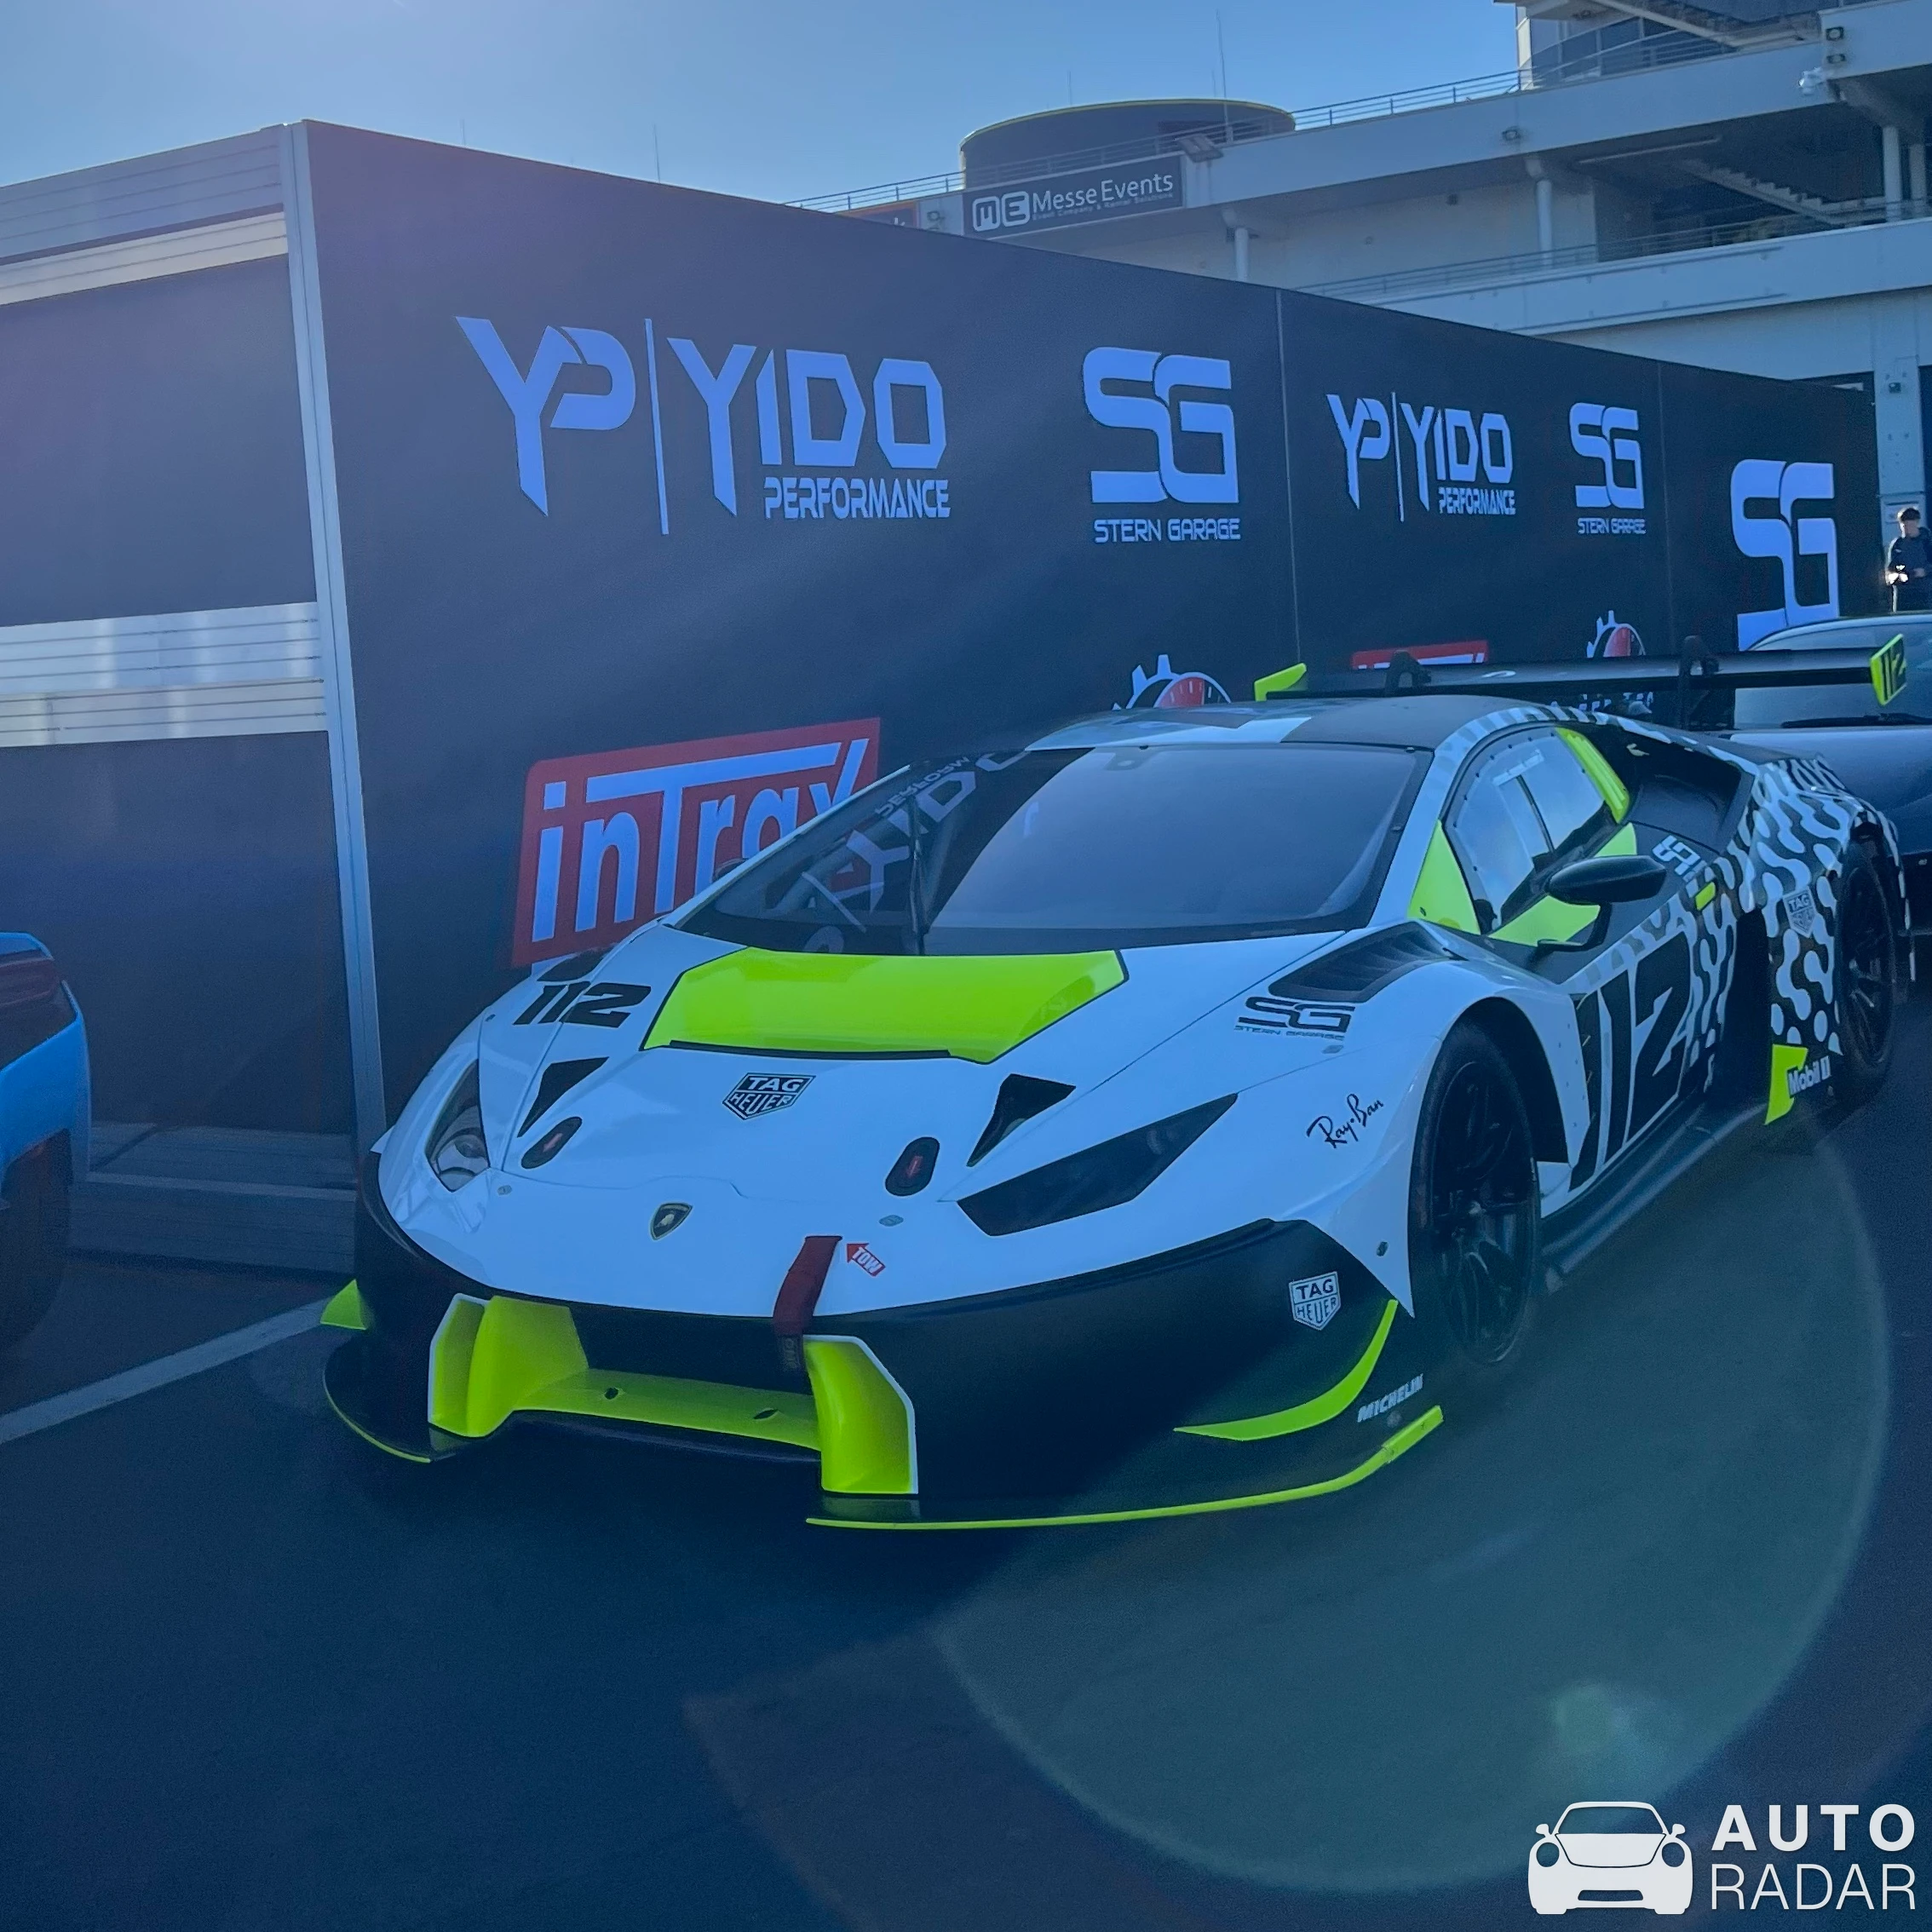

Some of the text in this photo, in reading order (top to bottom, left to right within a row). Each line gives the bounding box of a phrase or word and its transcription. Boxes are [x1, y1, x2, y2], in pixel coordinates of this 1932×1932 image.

[1032, 173, 1174, 212] Messe Events
[666, 337, 947, 517] YIDO
[1083, 346, 1239, 503] SG
[1400, 401, 1514, 511] YIDO
[1569, 402, 1645, 509] SG
[764, 475, 952, 520] PERFORMANCE
[1437, 486, 1516, 515] PERFORMANCE
[1094, 517, 1241, 543] STERN GARAGE
[1577, 518, 1647, 535] STERN GARAGE
[1730, 458, 1840, 651] SG
[1879, 635, 1906, 702] 112
[1789, 894, 1810, 913] TAG
[513, 980, 652, 1029] 112
[1238, 996, 1356, 1033] SG
[1234, 1025, 1345, 1041] STERN GARAGE
[1569, 931, 1691, 1192] 112
[1789, 1060, 1821, 1099] Mobil
[729, 1092, 794, 1116] HEUER
[748, 1077, 805, 1092] TAG
[852, 1246, 883, 1274] TOW
[1295, 1278, 1335, 1300] TAG
[1297, 1297, 1337, 1324] HEUER
[1357, 1372, 1424, 1423] MICHELIN
